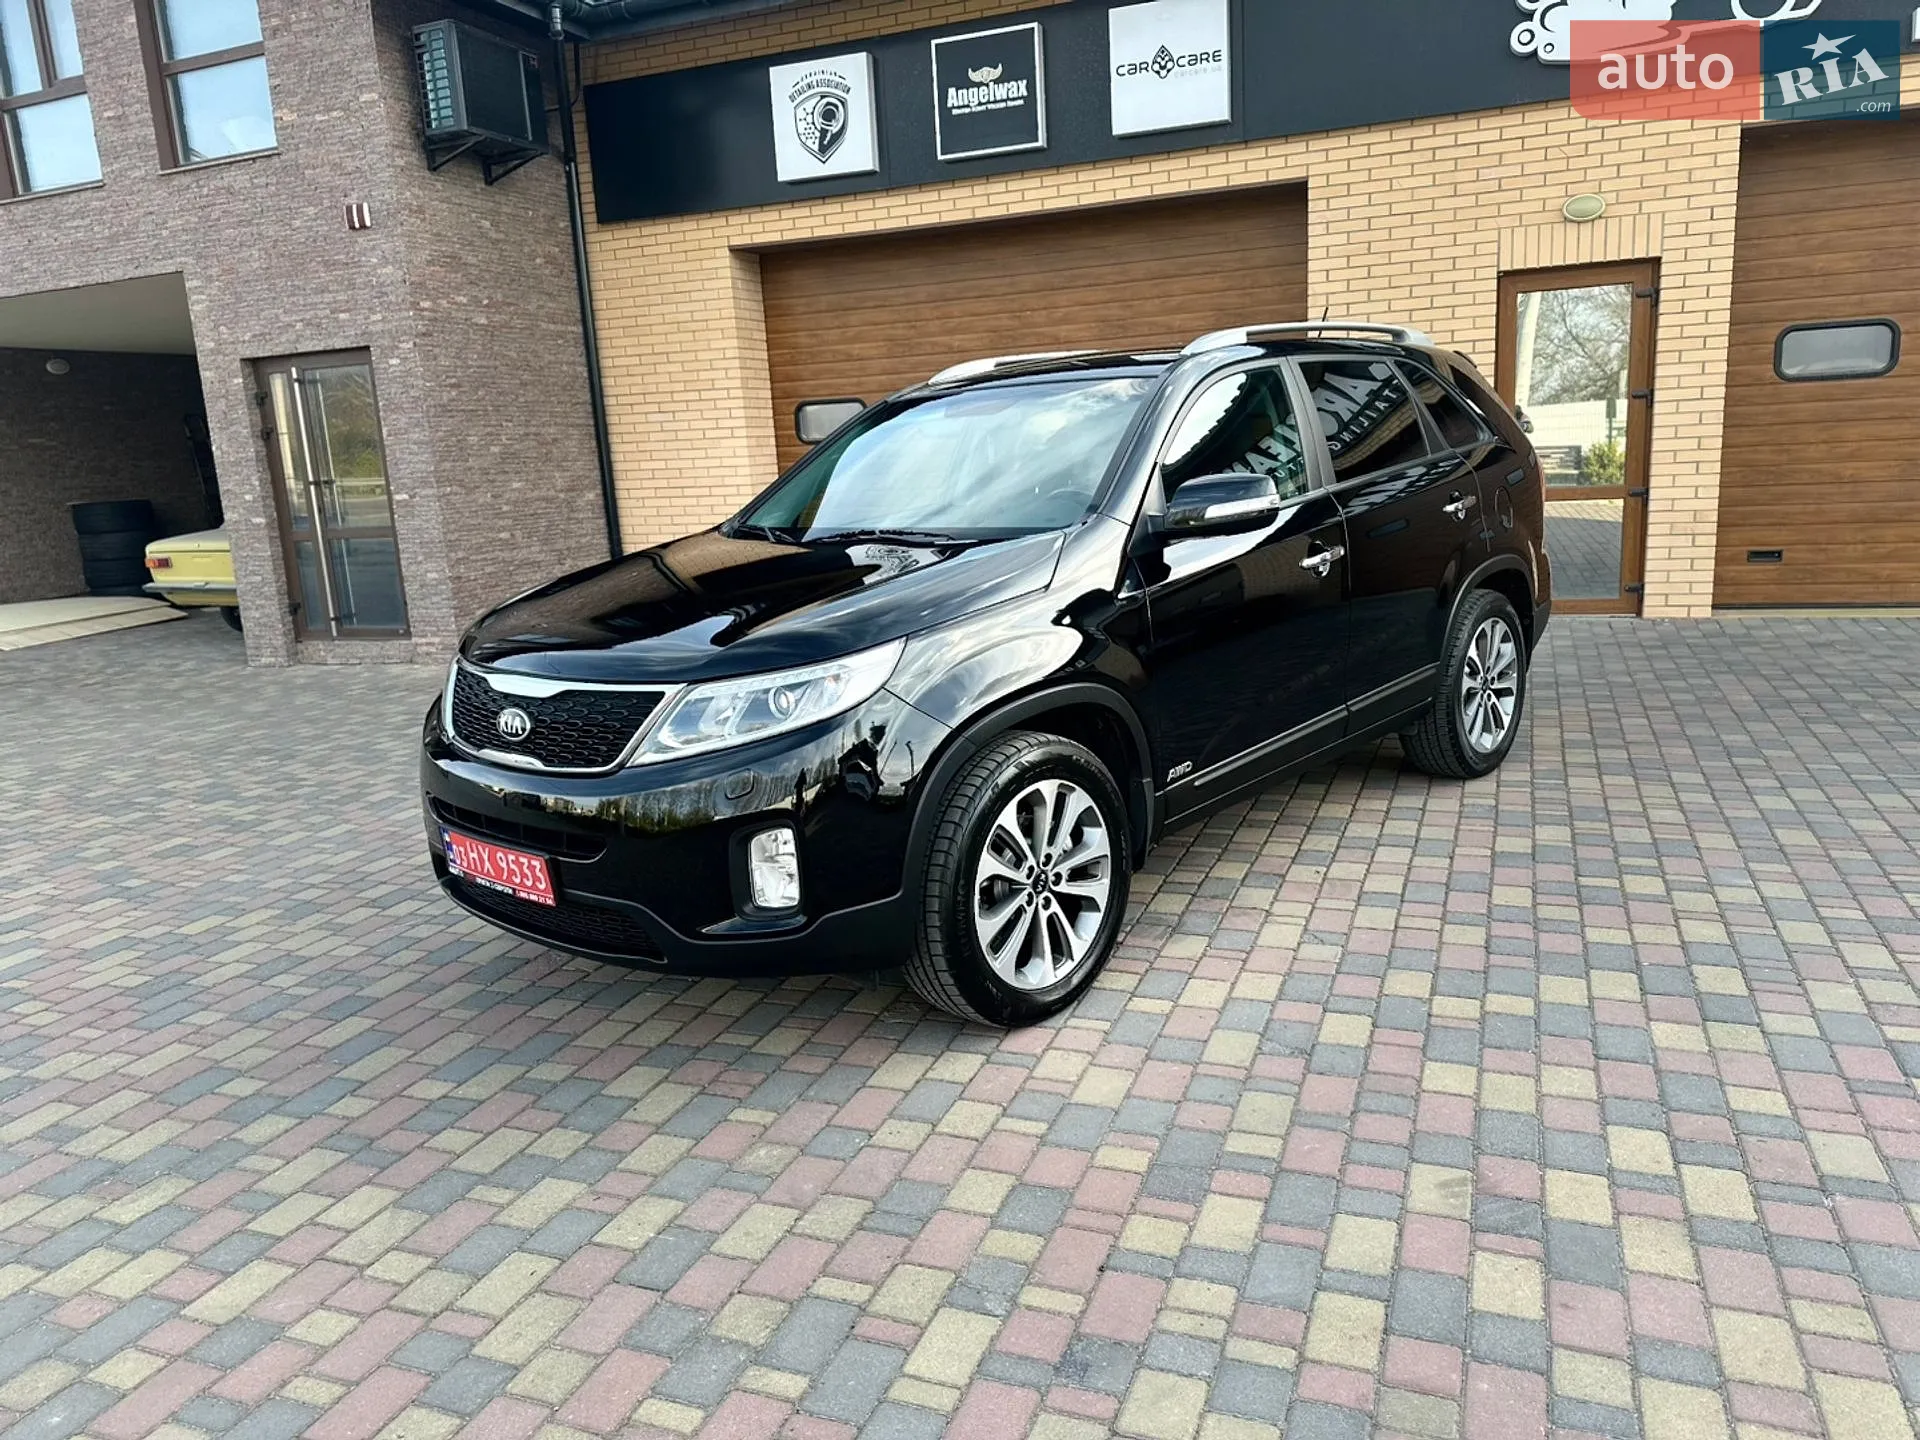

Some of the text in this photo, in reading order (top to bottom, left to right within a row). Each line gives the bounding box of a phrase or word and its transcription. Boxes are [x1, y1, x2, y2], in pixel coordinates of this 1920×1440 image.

[946, 79, 1028, 108] Angelwax
[500, 712, 524, 735] KIA
[496, 851, 547, 890] 9533
